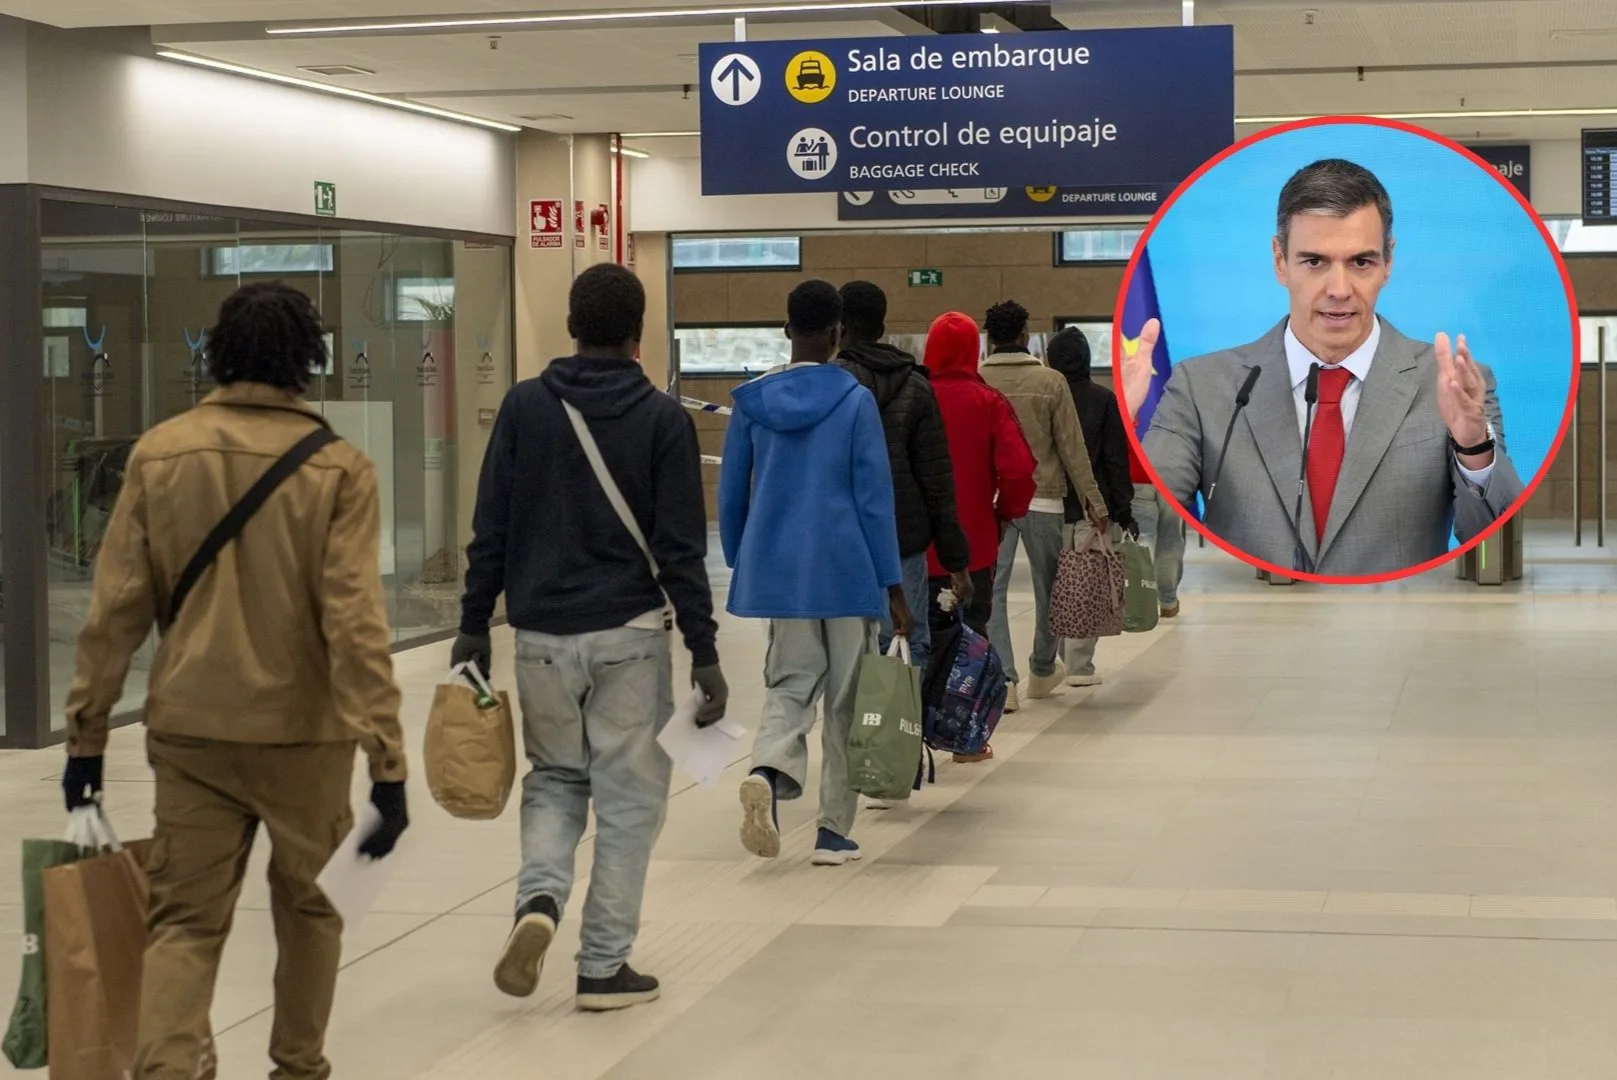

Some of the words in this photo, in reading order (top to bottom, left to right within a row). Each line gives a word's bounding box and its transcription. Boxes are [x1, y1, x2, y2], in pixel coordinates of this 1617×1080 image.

[847, 47, 901, 73] Sala
[910, 45, 943, 70] de
[951, 42, 1090, 72] embarque
[848, 86, 937, 103] DEPARTURE
[941, 84, 1005, 100] LOUNGE
[849, 121, 948, 149] Control
[957, 121, 991, 146] de
[999, 117, 1117, 150] equipaje
[849, 164, 925, 179] BAGGAGE
[929, 162, 979, 177] CHECK
[1062, 192, 1116, 203] DEPARTURE
[1118, 192, 1157, 203] LOUNGE
